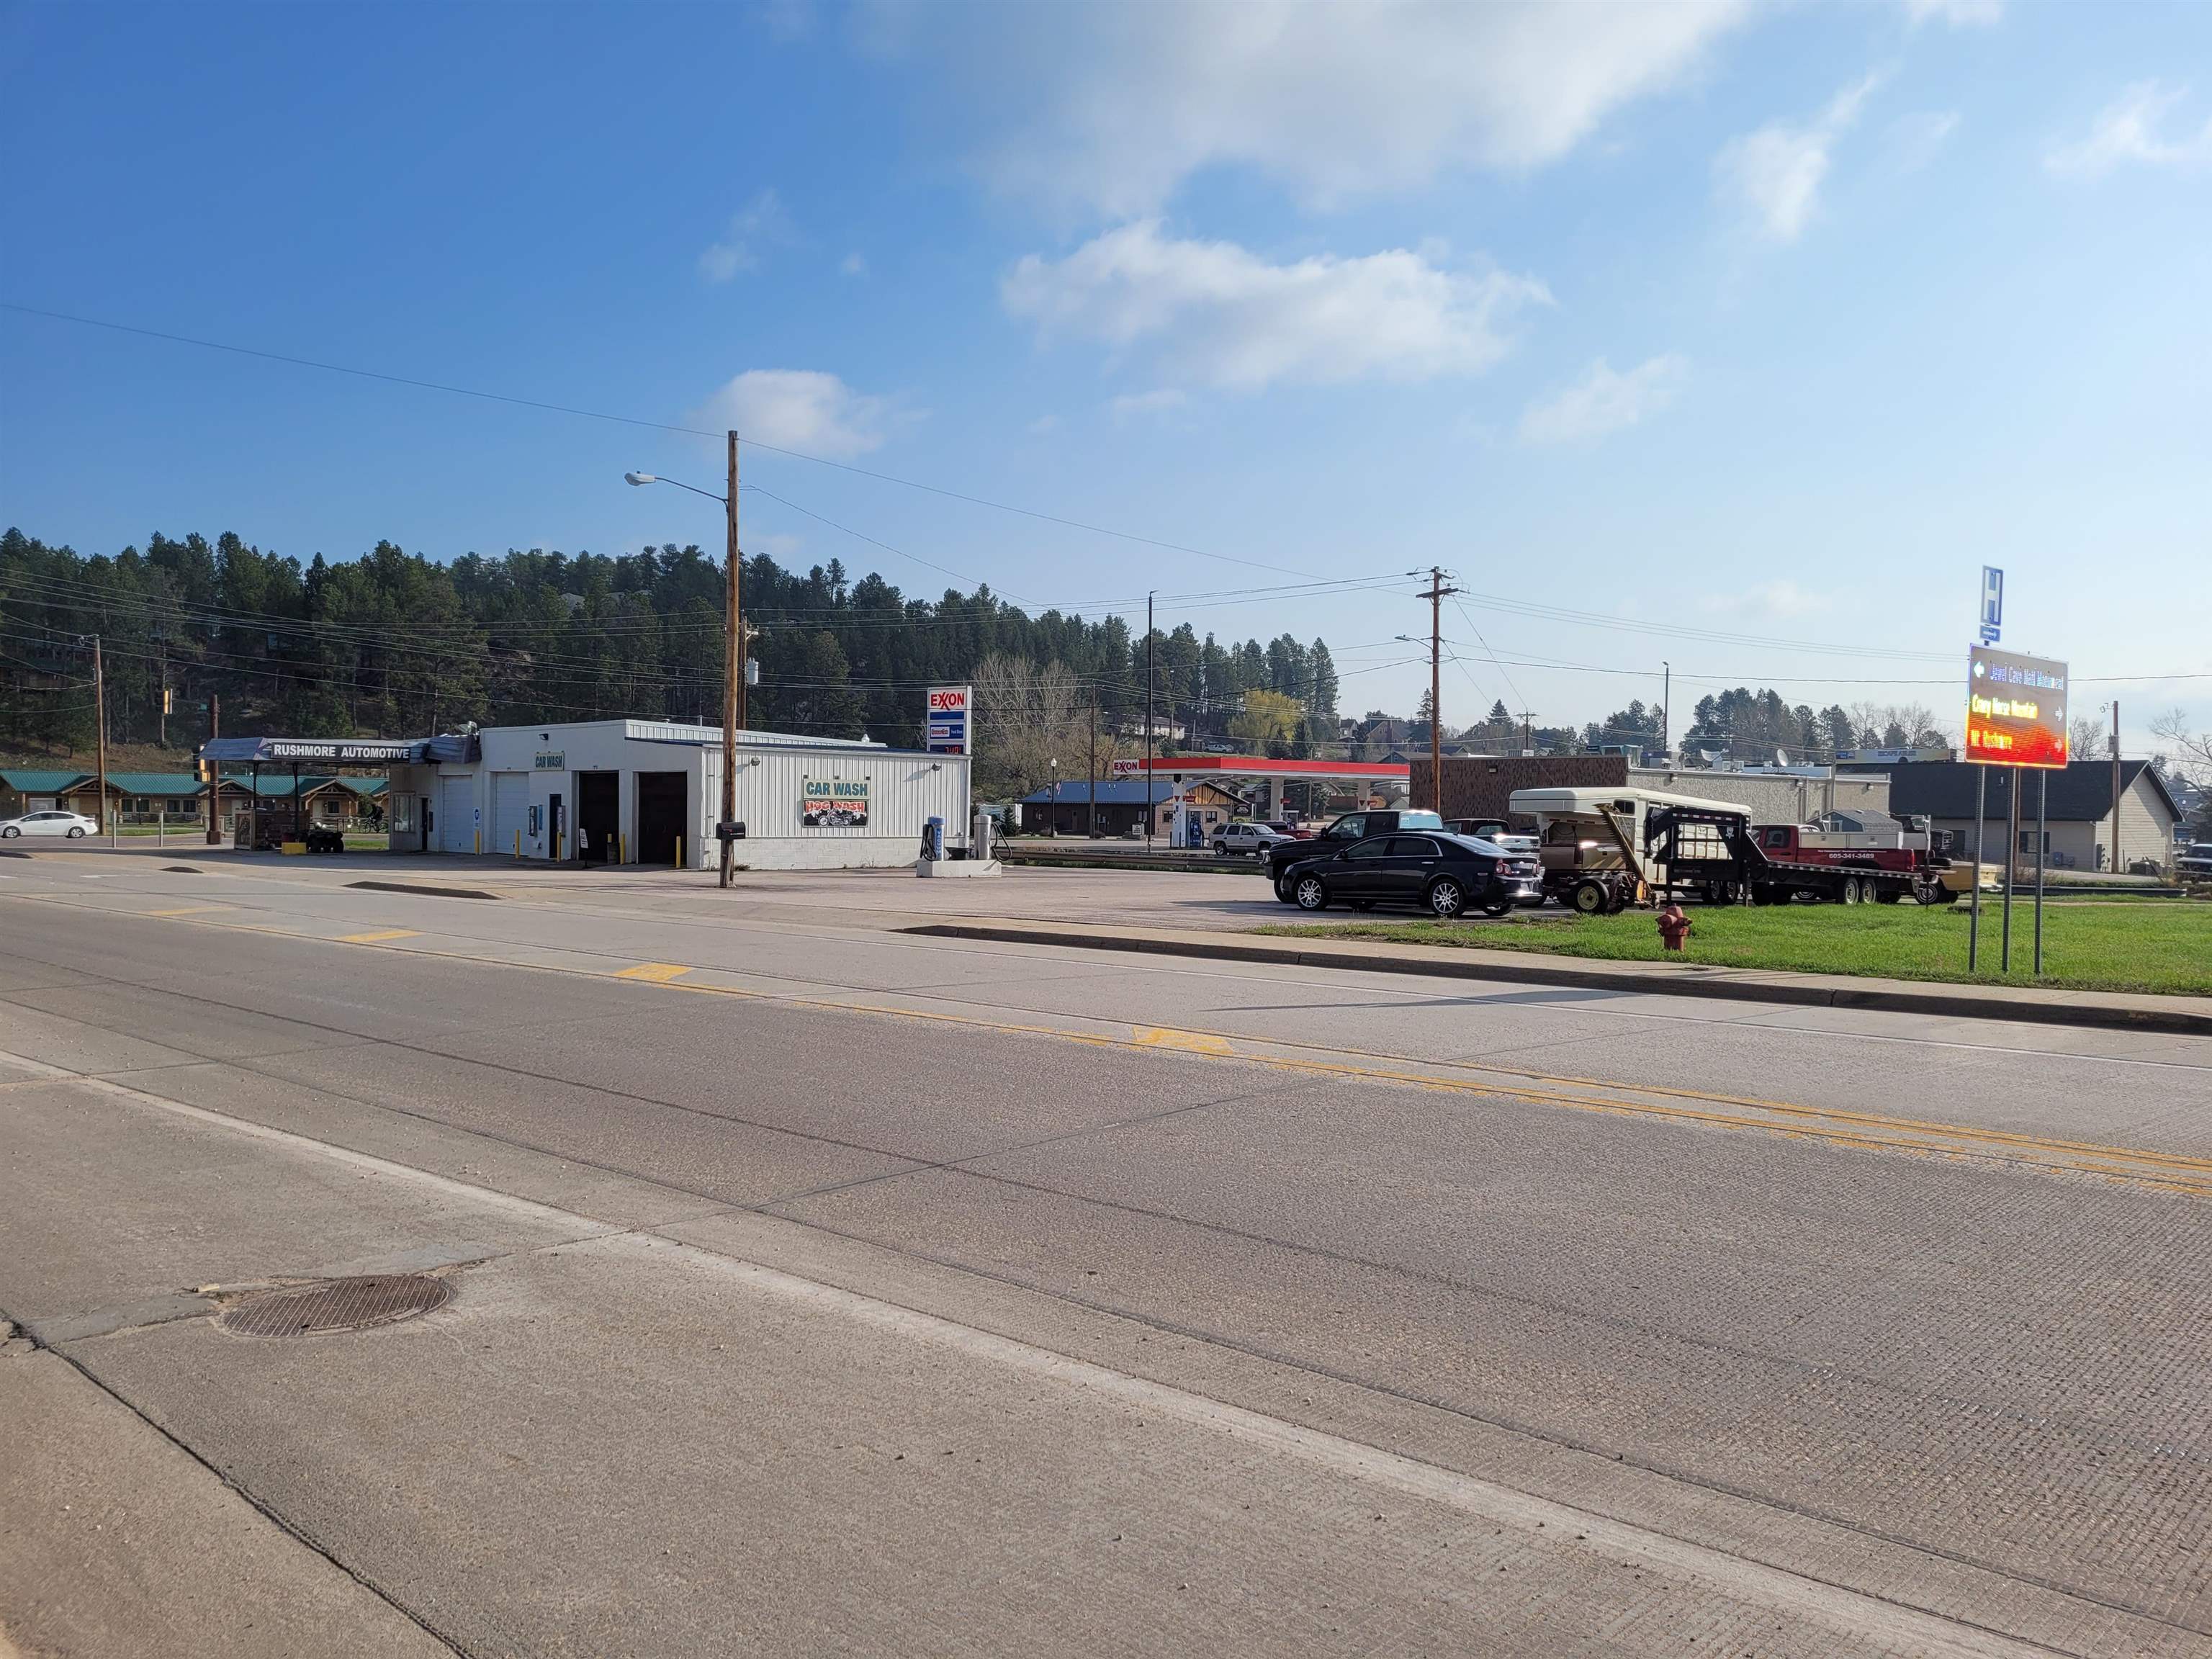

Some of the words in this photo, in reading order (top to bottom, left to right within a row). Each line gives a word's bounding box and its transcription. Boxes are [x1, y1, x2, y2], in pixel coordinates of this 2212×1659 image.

[1984, 569, 2000, 622] H
[1990, 663, 2007, 681] Jewel
[2008, 666, 2022, 684] Cave
[931, 692, 965, 711] EXXON
[274, 745, 336, 757] RUSHMORE
[341, 747, 410, 759] AUTOMOTIVE
[535, 756, 547, 768] CAR
[547, 755, 562, 768] WASH
[1114, 761, 1138, 773] EXXON
[806, 782, 830, 796] CAR
[834, 783, 868, 796] WASH
[805, 801, 830, 814] HOG
[832, 801, 865, 814] WASH
